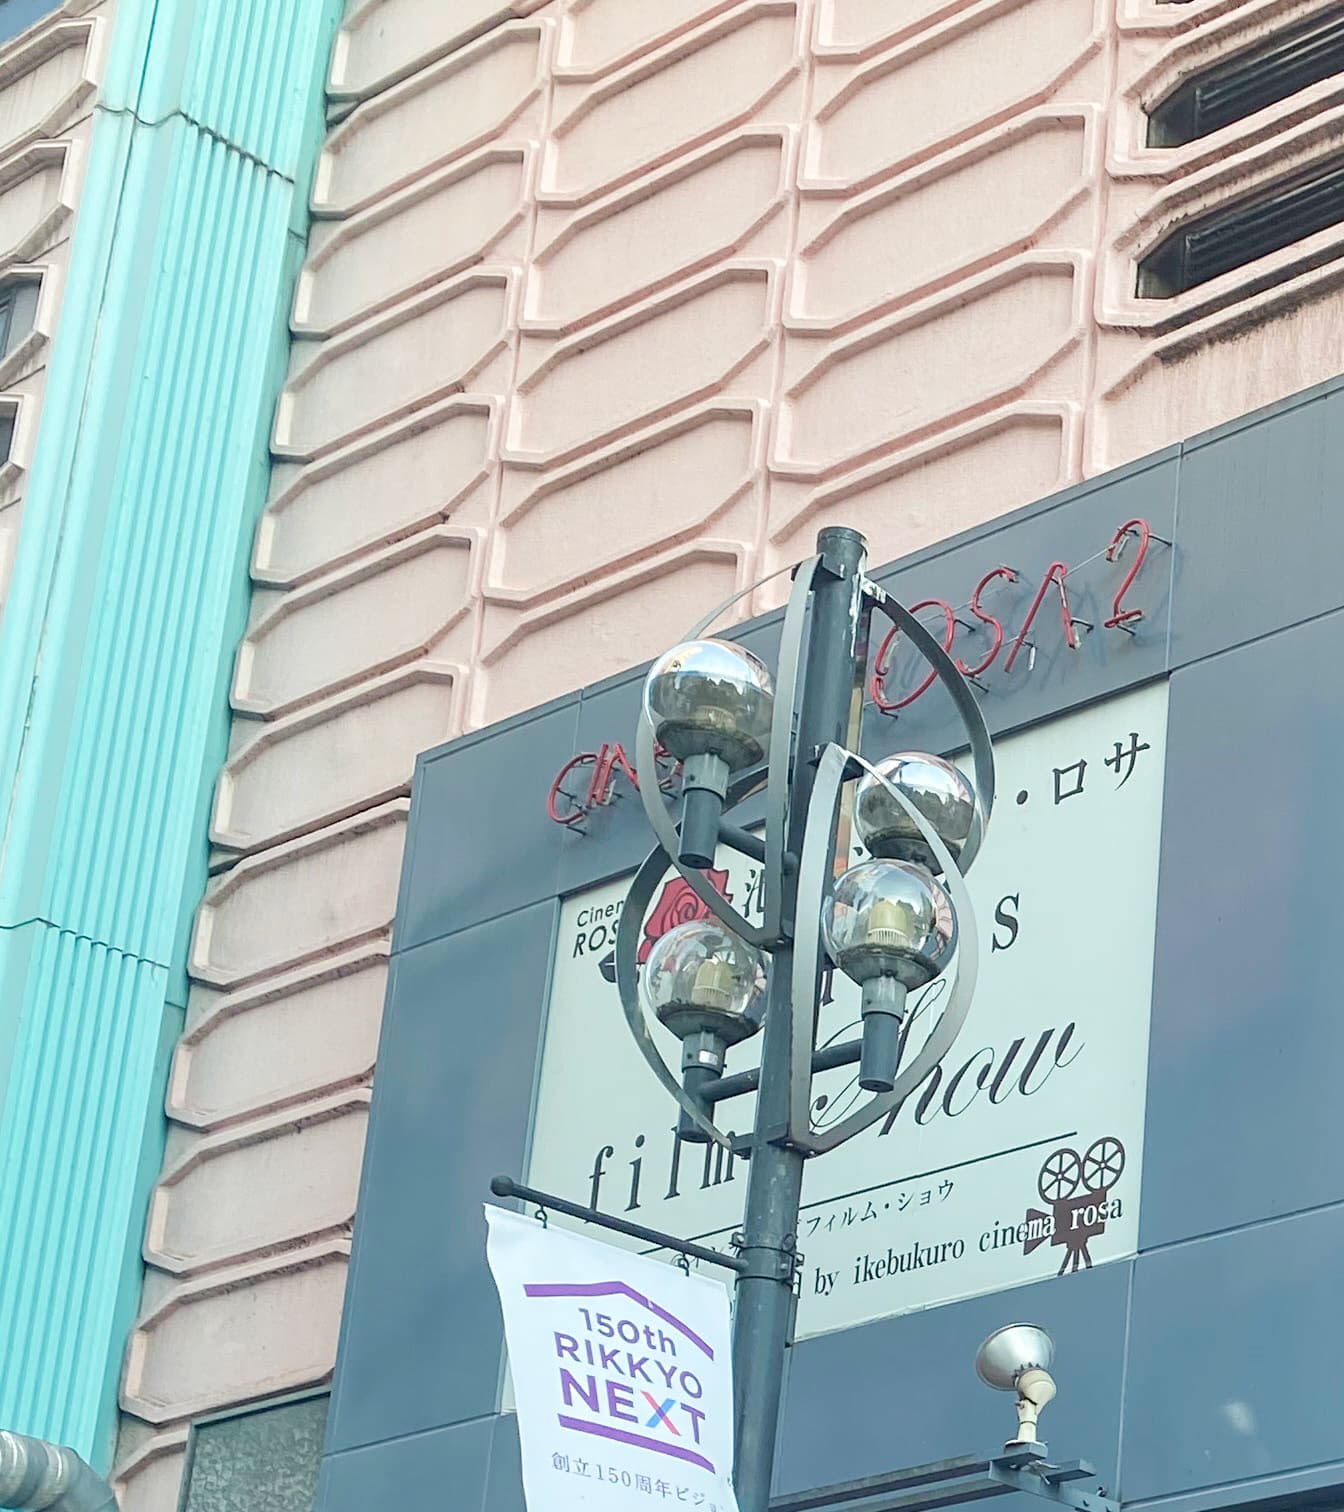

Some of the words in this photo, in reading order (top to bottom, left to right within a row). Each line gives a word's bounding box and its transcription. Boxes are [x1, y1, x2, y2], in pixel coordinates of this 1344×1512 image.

[868, 566, 1077, 710] OSA
[572, 919, 619, 959] ROS
[576, 900, 625, 928] Cine
[814, 1267, 842, 1297] by
[853, 1238, 966, 1285] ikebukuro
[979, 1213, 1057, 1253] cinema
[1069, 1197, 1124, 1231] rosa
[554, 1331, 704, 1400] RIKKYO
[578, 1307, 678, 1358] 150th
[559, 1367, 707, 1446] NEXT
